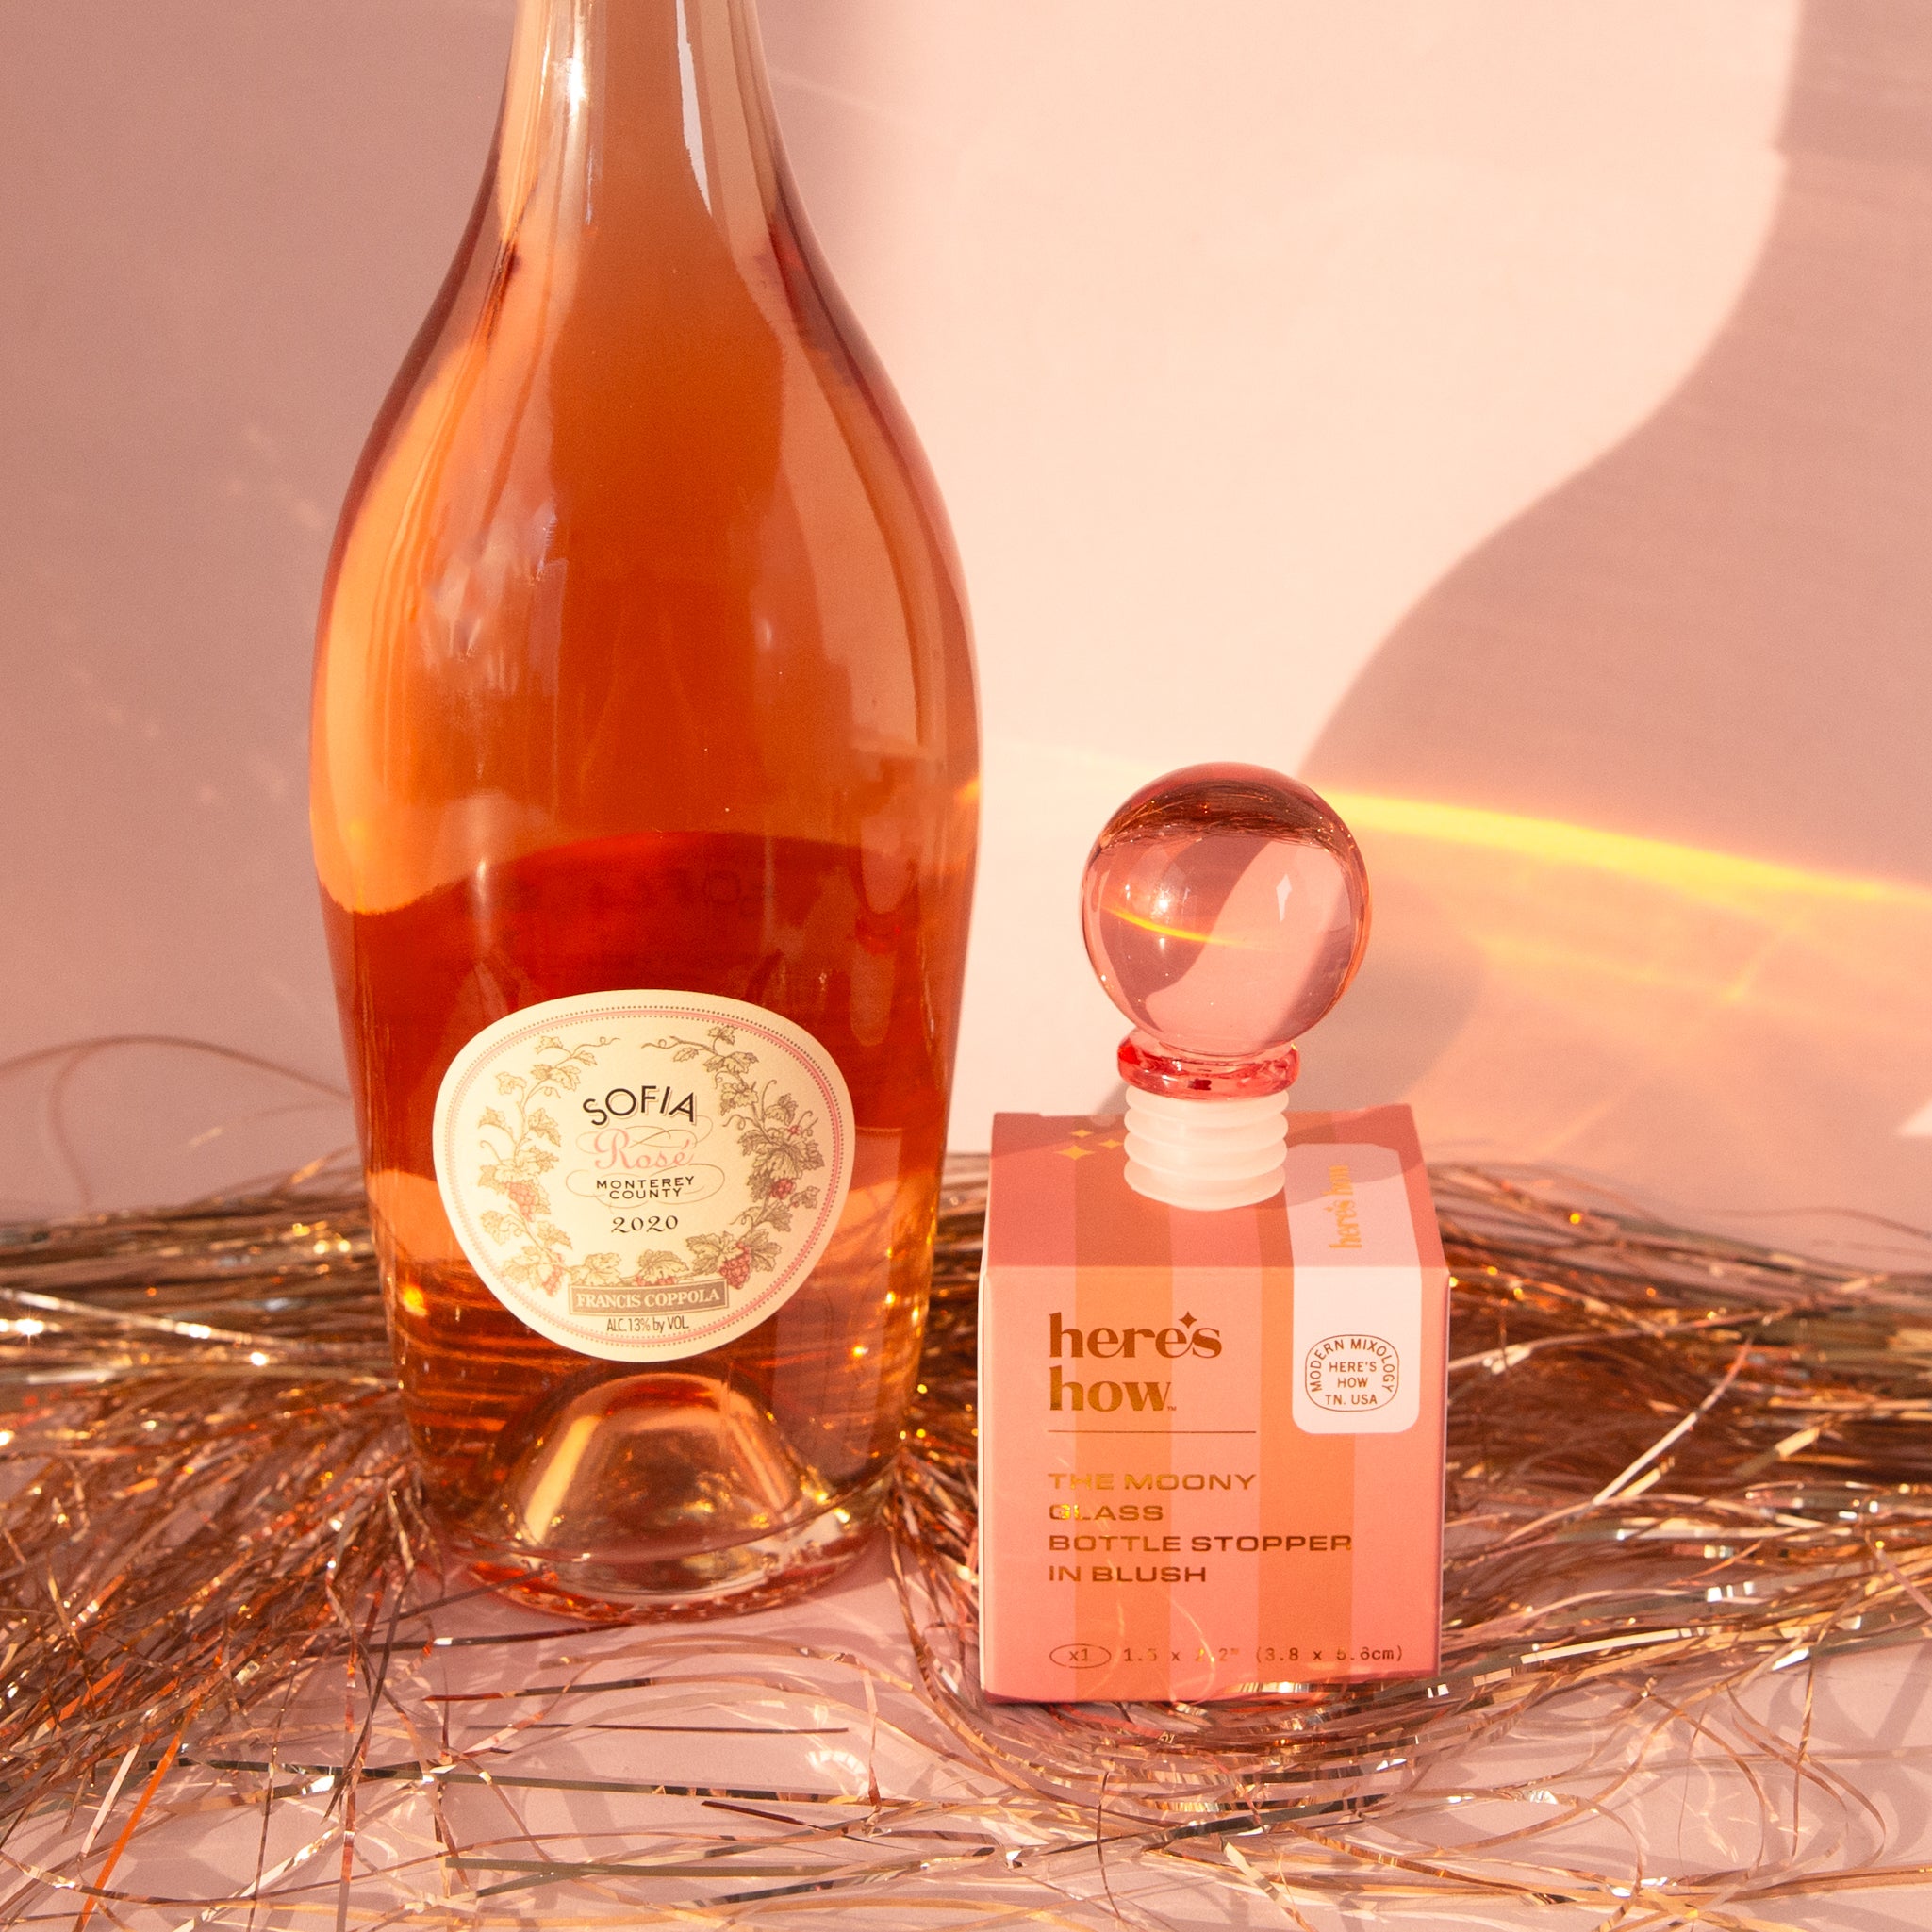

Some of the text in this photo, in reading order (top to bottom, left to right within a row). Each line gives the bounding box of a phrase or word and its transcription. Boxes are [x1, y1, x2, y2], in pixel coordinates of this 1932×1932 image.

[582, 1085, 697, 1129] SOFIA
[593, 1128, 695, 1170] Rosé
[596, 1175, 695, 1190] MONTEREY
[609, 1187, 682, 1199] COUNTY
[611, 1214, 679, 1234] 2020
[576, 1288, 720, 1309] FRANCIS COPPOLA
[652, 1316, 666, 1333] by
[1309, 1338, 1395, 1393] MODERN MIXOLOGY
[1329, 1361, 1377, 1373] HERE'S
[1049, 1364, 1172, 1412] how
[1337, 1377, 1368, 1389] HOW
[1325, 1393, 1378, 1406] TN. USA
[1048, 1473, 1257, 1491] THE MOONY
[1049, 1504, 1164, 1521] GLASS
[1049, 1535, 1352, 1552] BOTTLE STOPPER
[1049, 1565, 1206, 1583] IN BLUSH
[1069, 1648, 1089, 1662] x1
[1123, 1648, 1157, 1662] 1.5
[1171, 1651, 1181, 1662] x
[1195, 1647, 1240, 1662] 22"
[1256, 1646, 1299, 1663] (3.8
[1313, 1650, 1322, 1661] x
